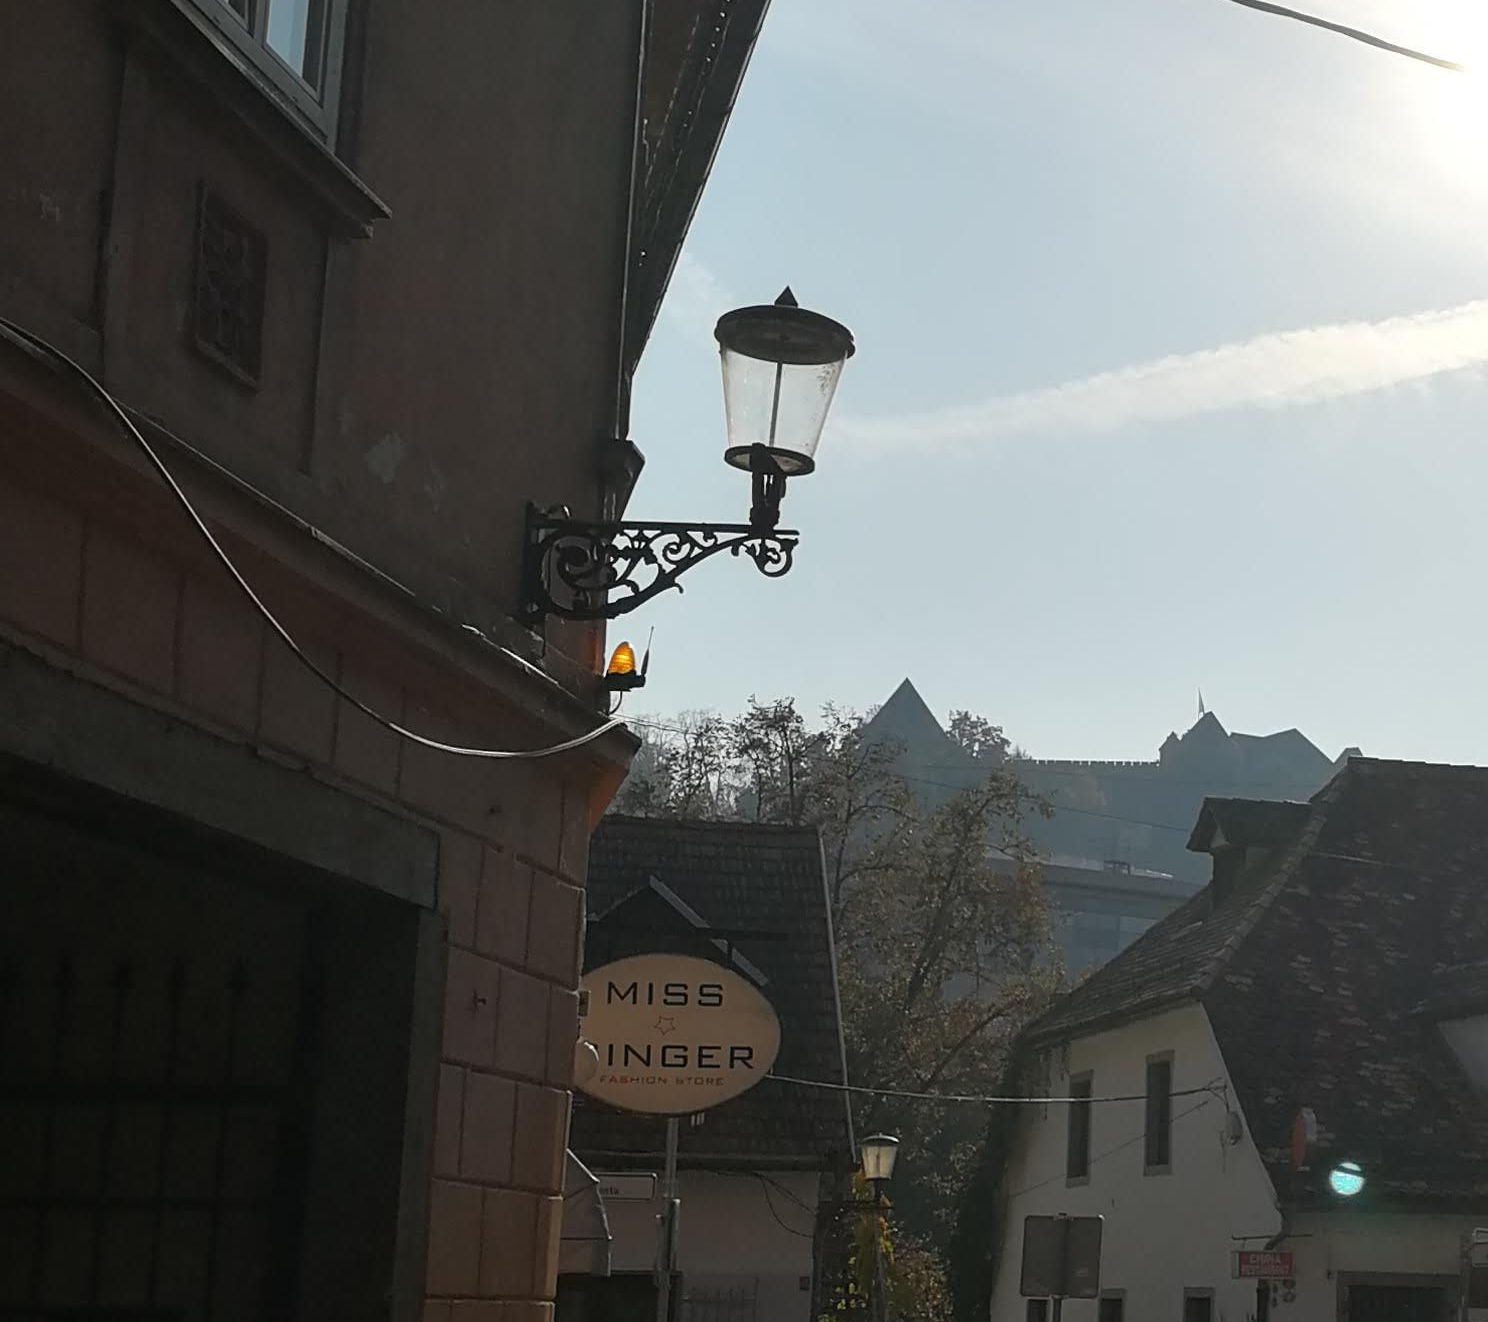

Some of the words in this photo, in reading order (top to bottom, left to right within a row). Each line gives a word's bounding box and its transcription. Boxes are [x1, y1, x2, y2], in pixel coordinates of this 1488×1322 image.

[607, 981, 724, 1007] MISS
[592, 1043, 754, 1069] INGER
[601, 1075, 667, 1085] FASHION
[675, 1077, 724, 1087] STORE
